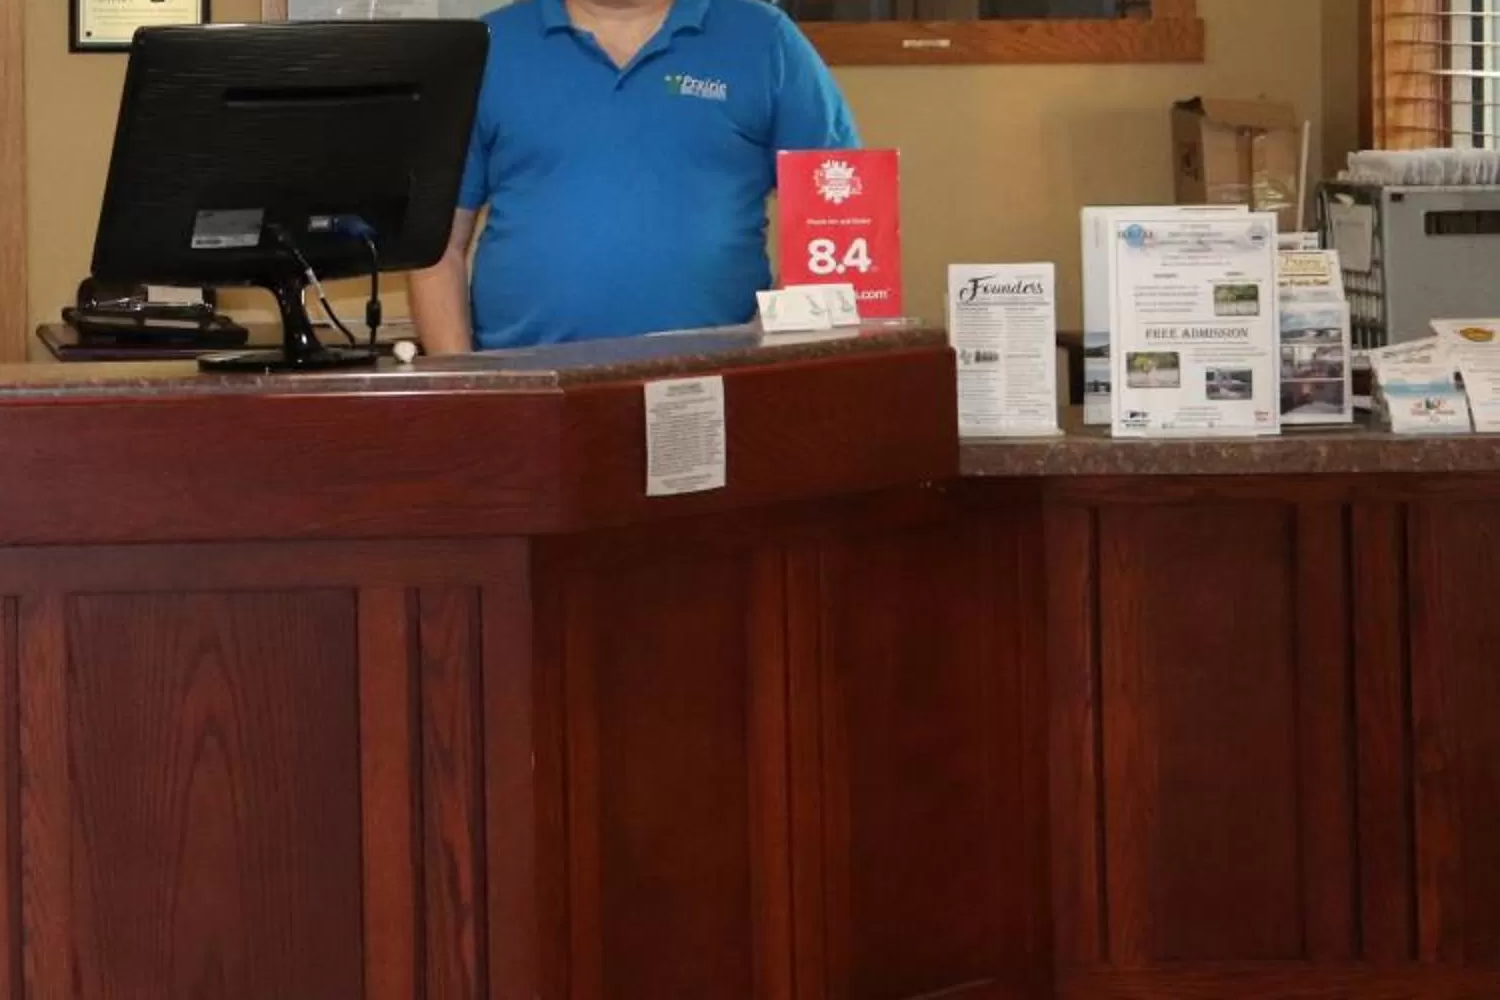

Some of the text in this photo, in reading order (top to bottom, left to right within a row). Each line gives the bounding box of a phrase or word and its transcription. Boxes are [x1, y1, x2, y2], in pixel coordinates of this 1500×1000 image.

[807, 237, 872, 275] 8.4
[959, 274, 1045, 304] Founders
[1145, 327, 1250, 340] FREE ADMISSION
